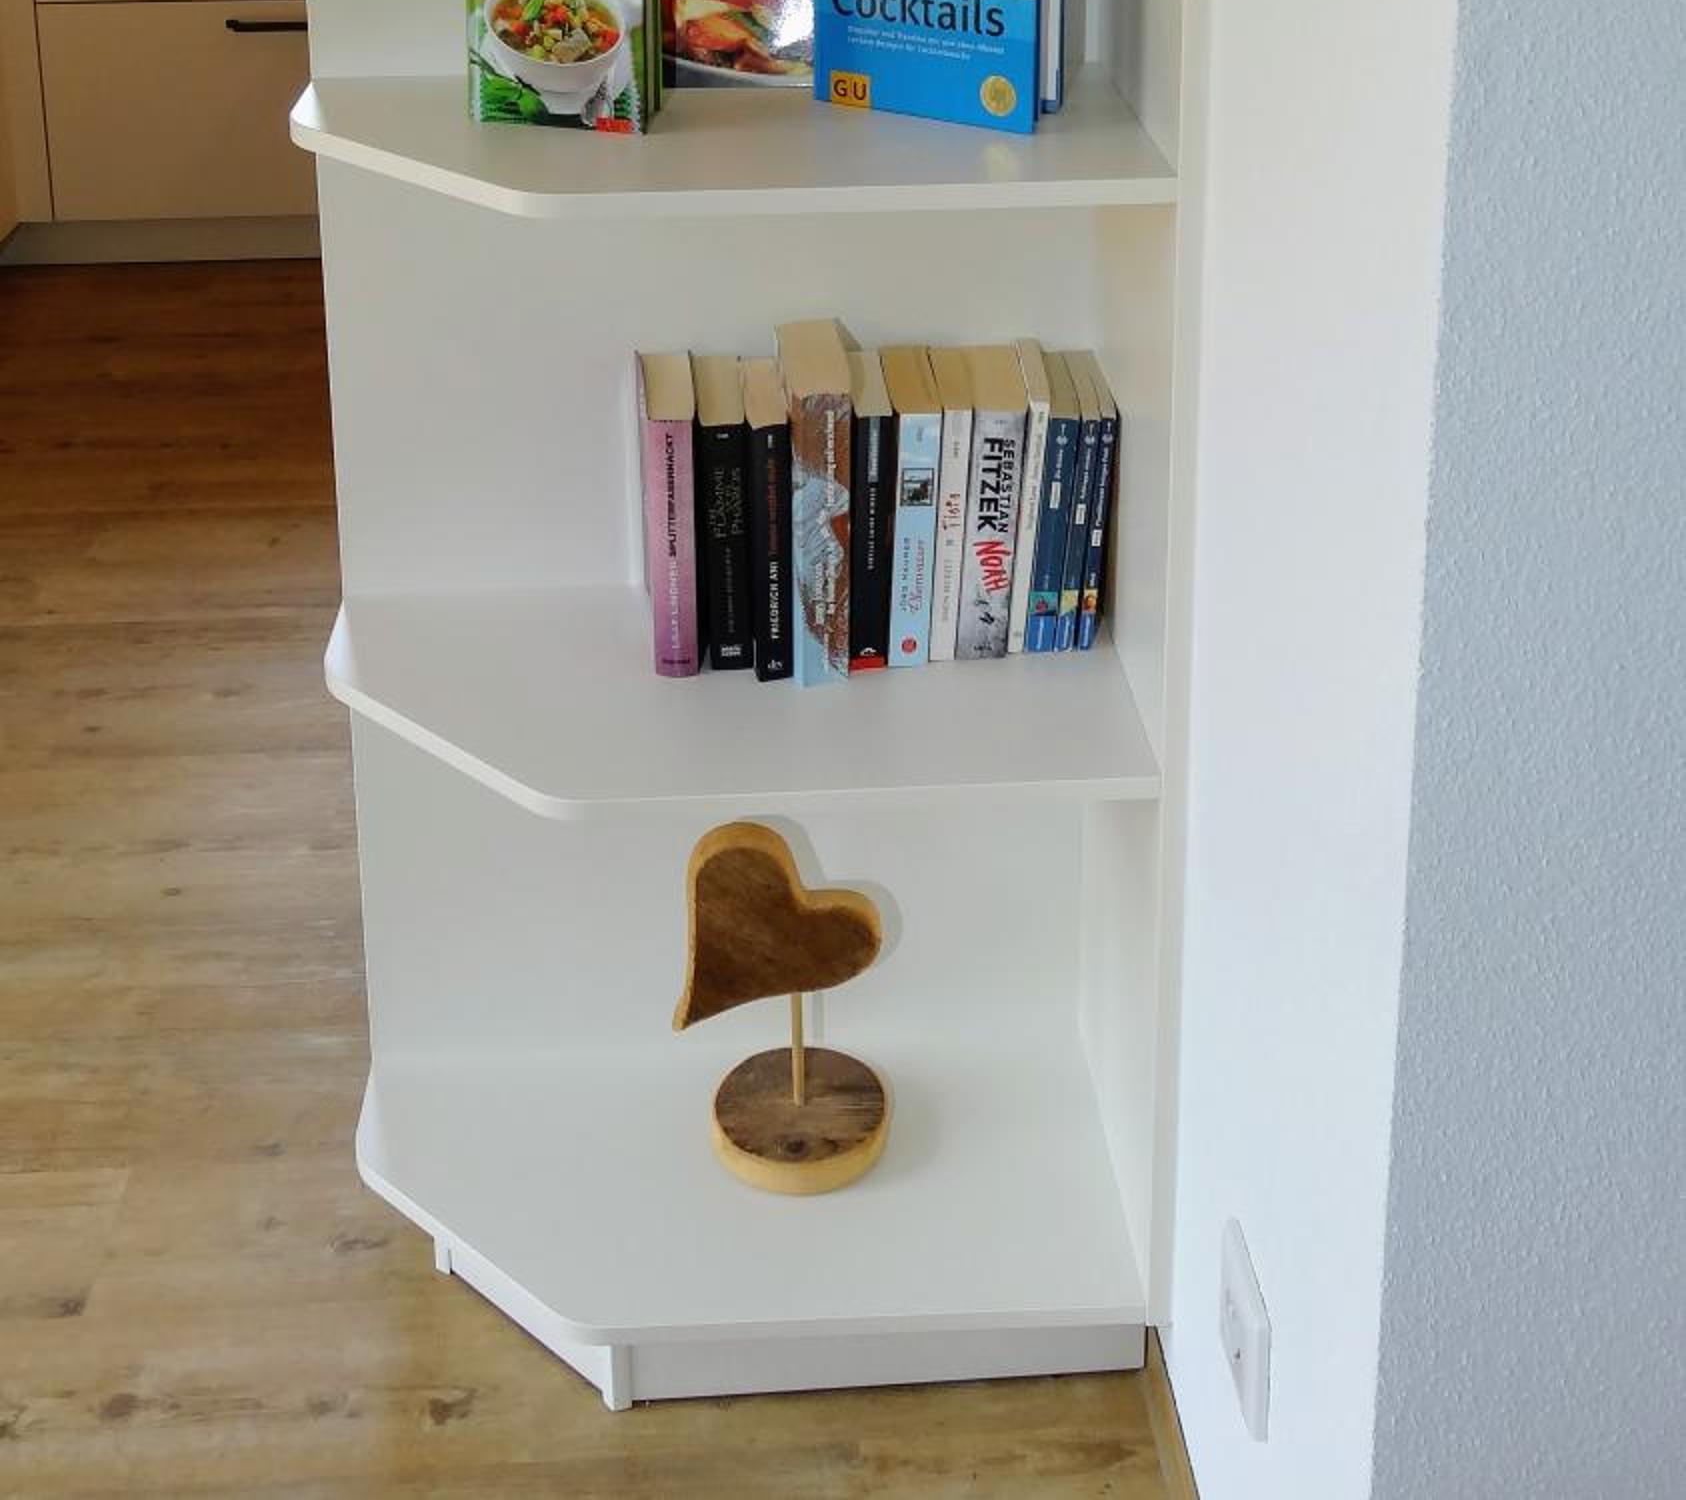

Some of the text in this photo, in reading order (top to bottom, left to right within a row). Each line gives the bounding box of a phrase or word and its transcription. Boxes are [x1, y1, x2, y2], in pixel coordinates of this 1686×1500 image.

[978, 437, 1000, 532] FITZEK
[1001, 438, 1016, 533] SEBASTIAN
[973, 540, 1011, 594] NOAH
[770, 583, 780, 639] FRIEDRICH
